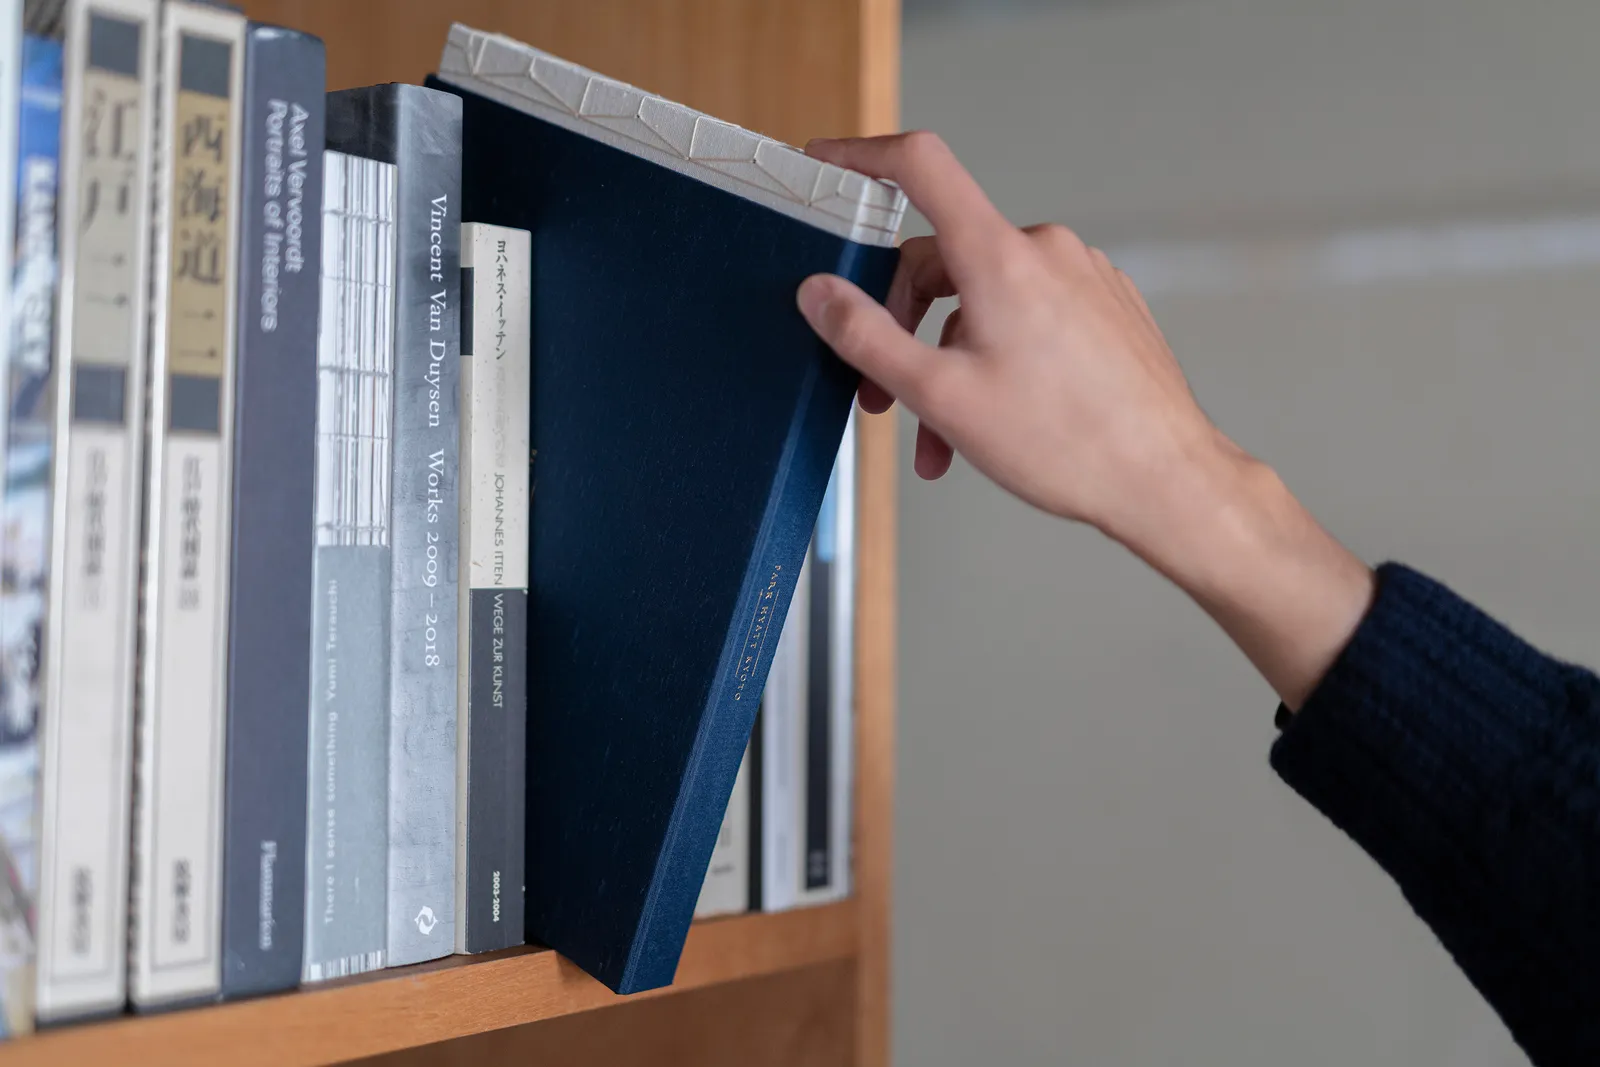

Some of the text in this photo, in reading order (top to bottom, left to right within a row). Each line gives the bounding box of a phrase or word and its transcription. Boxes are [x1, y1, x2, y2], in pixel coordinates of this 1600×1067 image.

[260, 99, 288, 333] Portraits of Interiors
[285, 102, 310, 273] Axel Vervoordt
[430, 194, 447, 283] Vincent
[429, 289, 446, 331] Van
[495, 240, 508, 360] ヨハネス・イッテン
[424, 339, 446, 428] Duysen
[427, 448, 445, 523] Works
[494, 472, 505, 547] JOHANNES
[421, 531, 439, 588] 2009
[493, 550, 504, 586] ITTEN
[325, 579, 338, 652] Terauchi
[425, 613, 440, 667] 2018
[493, 593, 504, 635] WEGE
[734, 564, 782, 701] PARK HYATT KYOTO
[492, 638, 504, 663] ZUR
[325, 658, 338, 701] Yumi
[492, 665, 503, 708] KUNST
[325, 711, 339, 801] something
[325, 808, 336, 858] sense
[324, 876, 336, 925] There
[492, 870, 501, 922] 2003-2004
